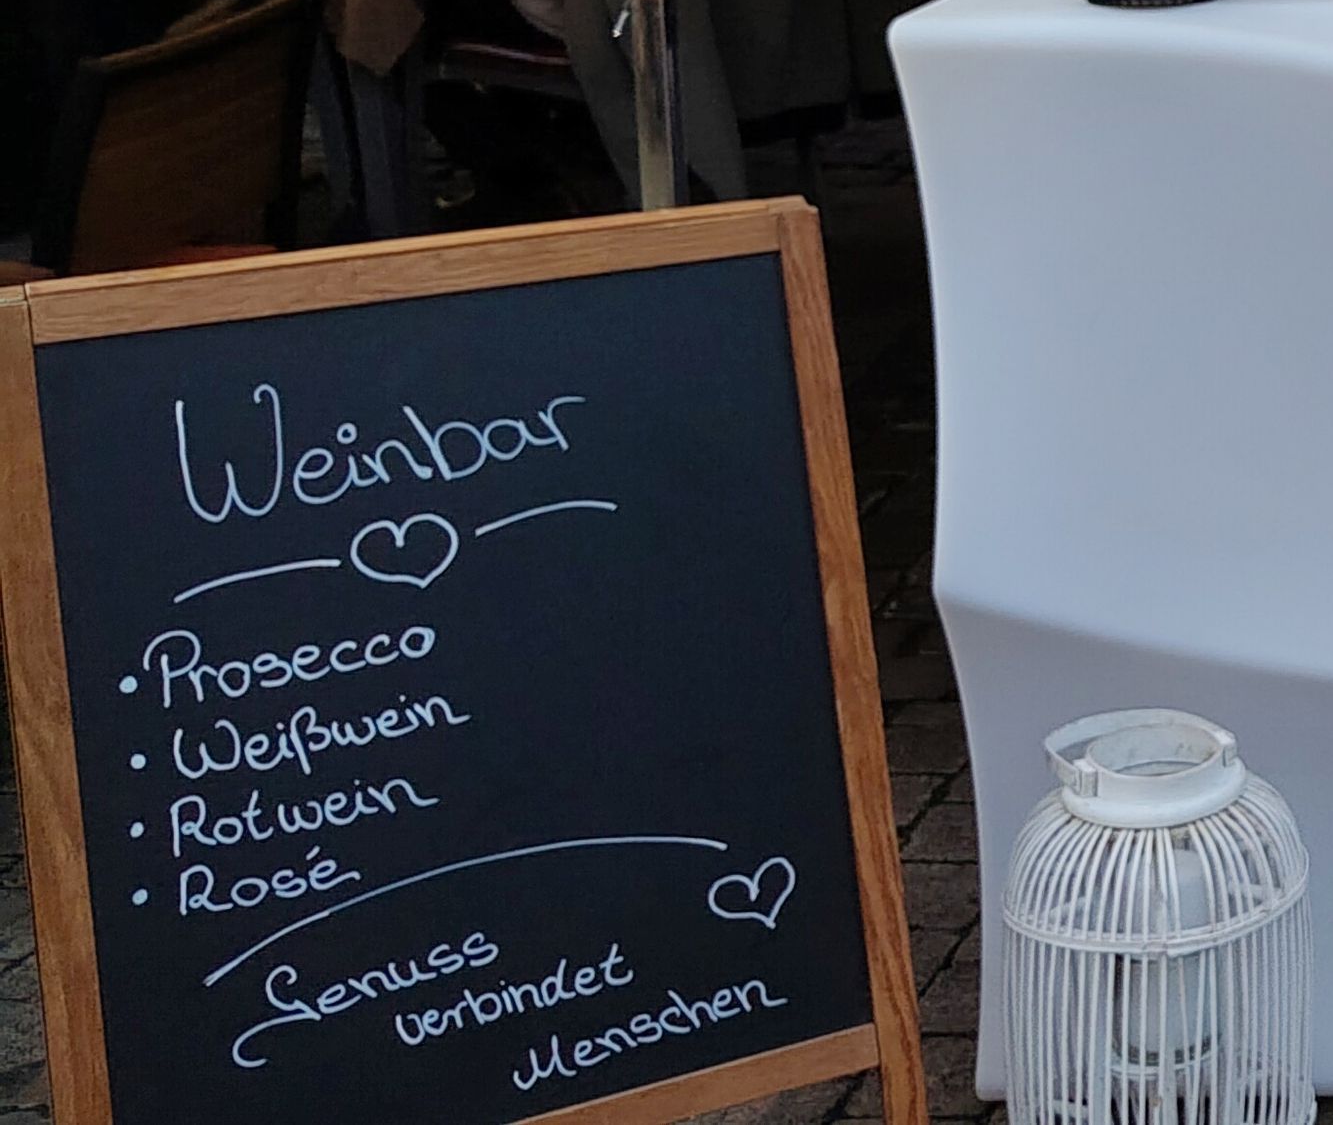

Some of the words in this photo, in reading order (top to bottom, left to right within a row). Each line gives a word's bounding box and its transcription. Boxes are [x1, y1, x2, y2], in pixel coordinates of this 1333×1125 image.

[175, 383, 586, 522] Weinbar
[142, 624, 436, 706] Prosecco
[172, 693, 470, 779] Weißwein
[171, 777, 438, 856] Rotwein
[178, 847, 360, 916] Rosé
[232, 930, 500, 1068] Genuss
[395, 942, 635, 1047] verbindet
[512, 979, 787, 1091] Menschen
